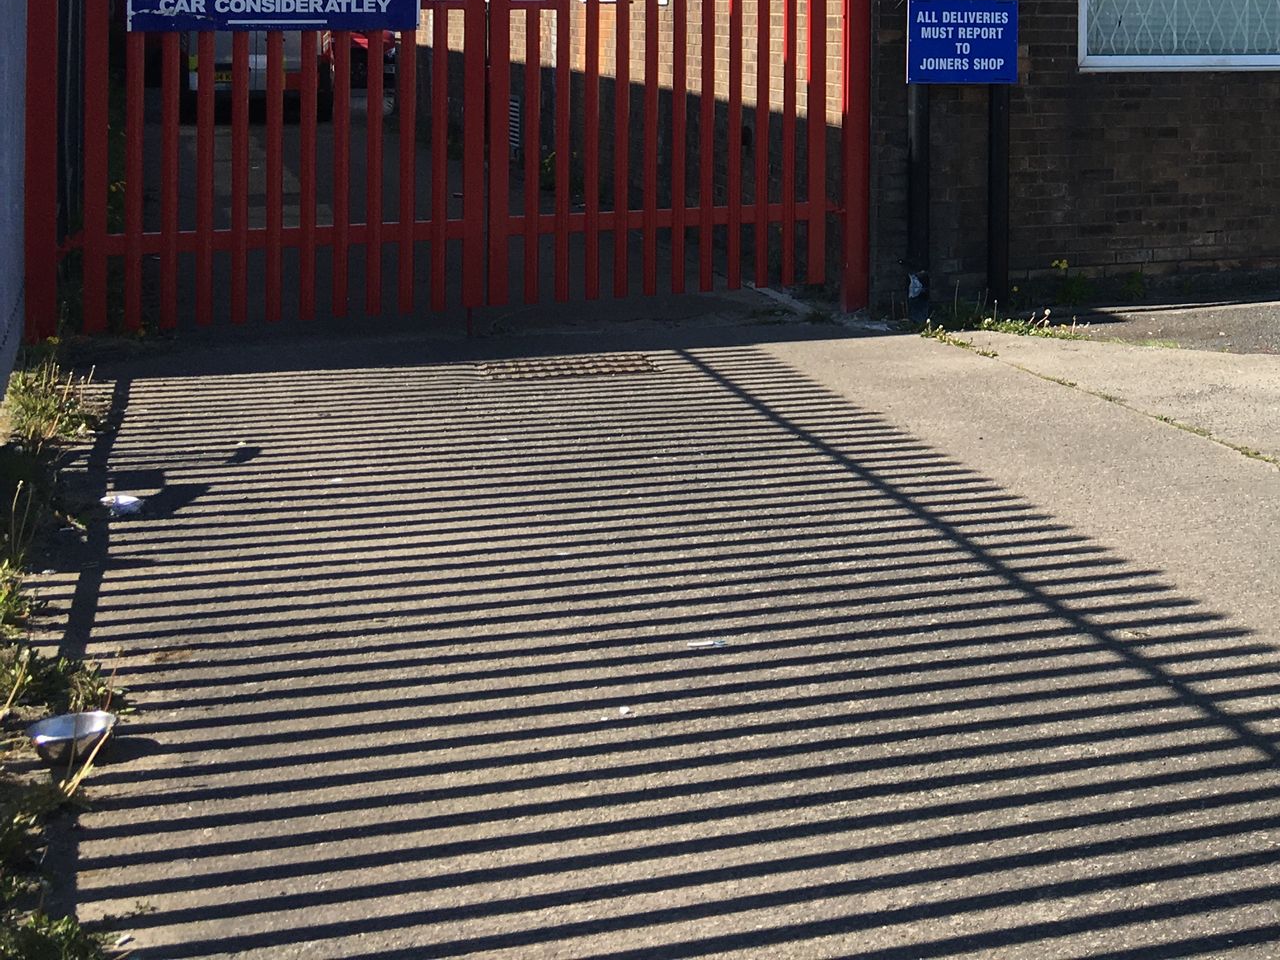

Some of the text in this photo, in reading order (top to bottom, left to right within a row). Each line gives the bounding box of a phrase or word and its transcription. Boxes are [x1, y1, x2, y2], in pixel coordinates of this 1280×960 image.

[917, 11, 1009, 24] ALL DELIVERIES
[921, 26, 1004, 39] MUST REPORT
[955, 42, 971, 55] TO
[919, 58, 1005, 71] JOINERS SHOP
